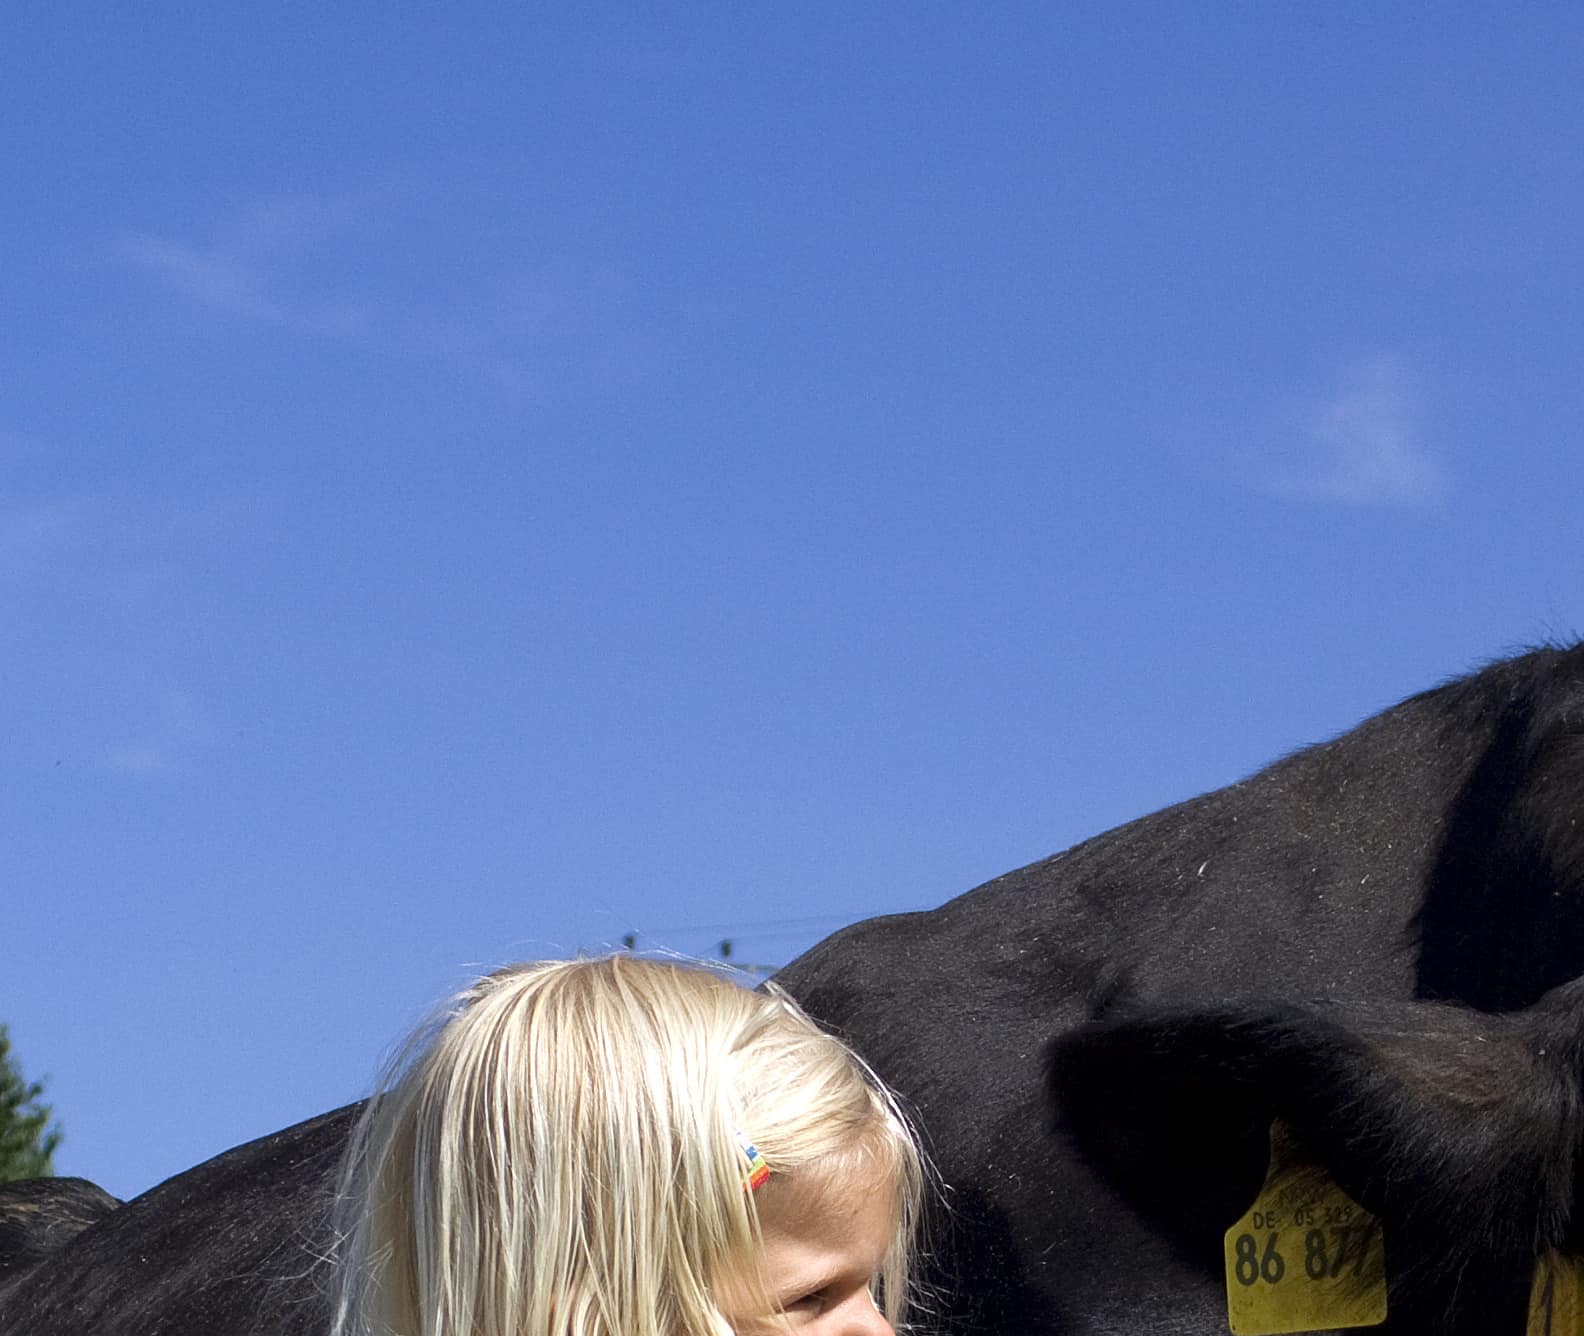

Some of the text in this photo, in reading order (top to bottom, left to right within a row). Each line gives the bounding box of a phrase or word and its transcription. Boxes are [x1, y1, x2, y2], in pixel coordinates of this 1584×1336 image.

[1253, 1206, 1352, 1230] DE 05 329
[1235, 1231, 1285, 1287] 86
